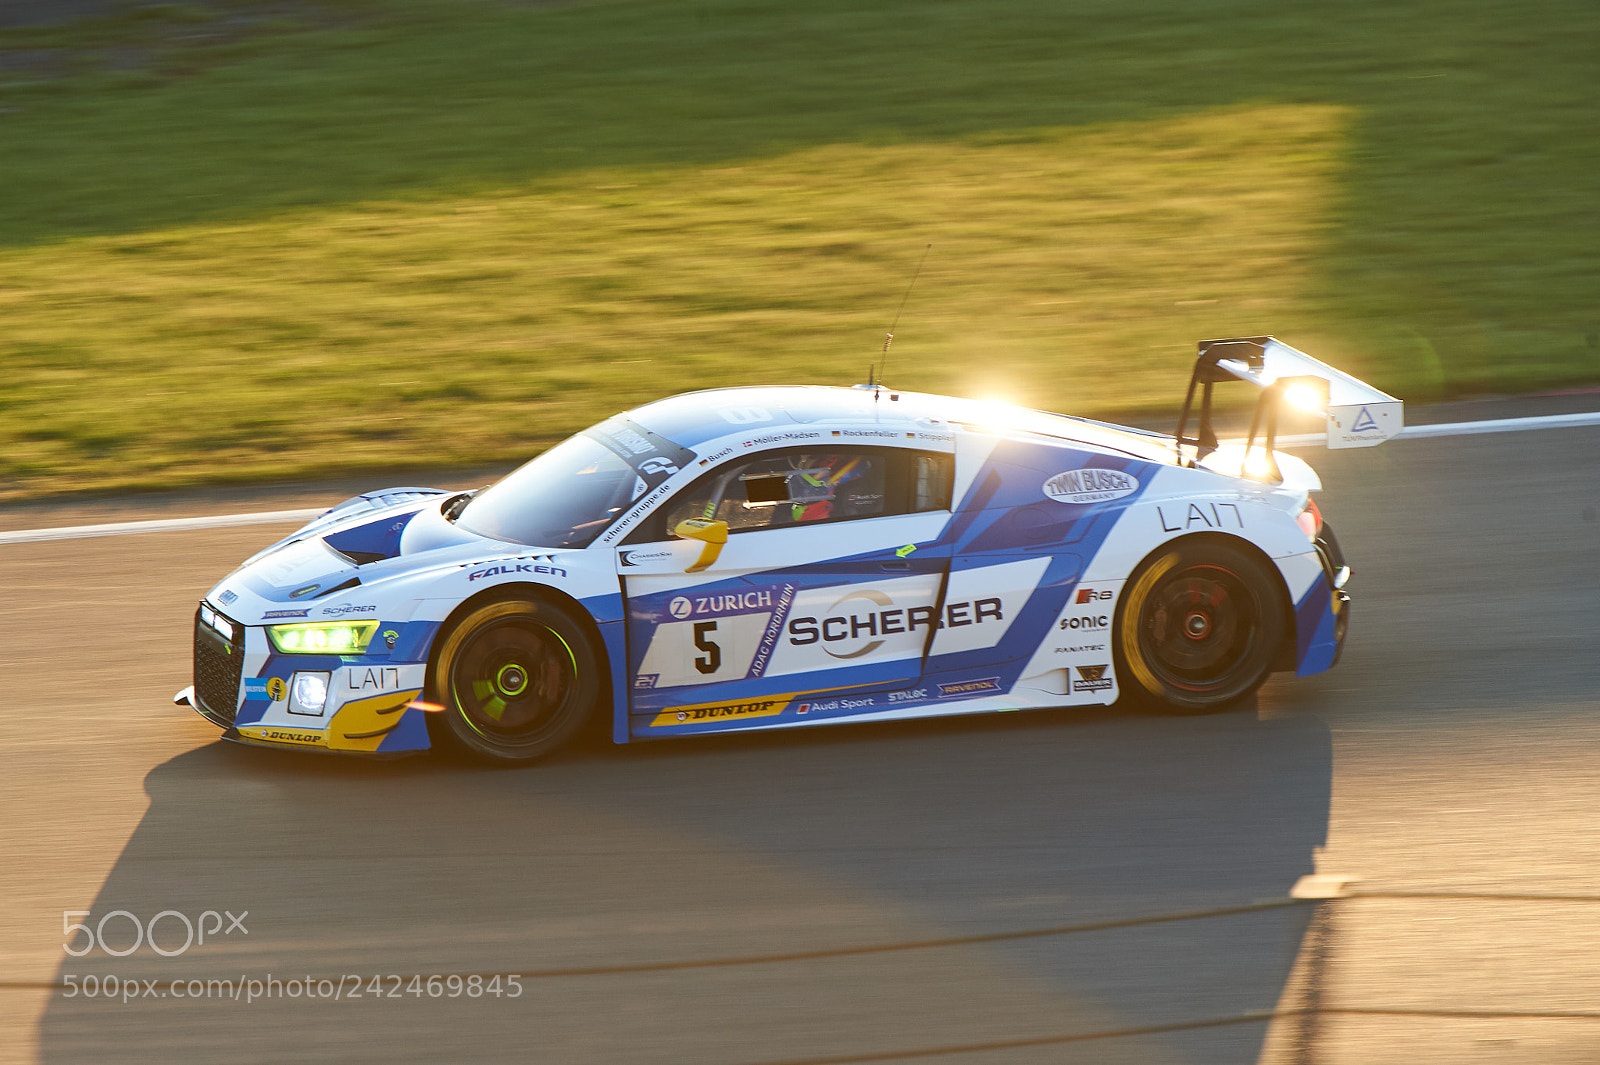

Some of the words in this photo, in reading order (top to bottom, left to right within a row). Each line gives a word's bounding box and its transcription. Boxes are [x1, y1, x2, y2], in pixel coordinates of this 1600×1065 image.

[842, 430, 898, 439] Rockenfeller
[708, 446, 734, 463] Busch
[1048, 475, 1082, 495] TWIN
[1083, 470, 1130, 492] BUSCH
[1074, 492, 1116, 503] GERMANY
[603, 483, 672, 545] scherer-gruppe.de
[468, 564, 567, 582] FALKEN
[323, 604, 377, 615] SCHERER
[695, 590, 772, 614] ZURICH
[751, 649, 771, 678] ADAC
[763, 582, 796, 646] NORDRHEIN
[788, 597, 1004, 646] SCHERER
[693, 621, 722, 674] 5
[943, 681, 995, 694] RAVENOL
[692, 701, 775, 721] DUNLOP
[812, 702, 840, 714] Audi
[842, 698, 875, 714] Sport
[268, 731, 322, 743] DUNLOP
